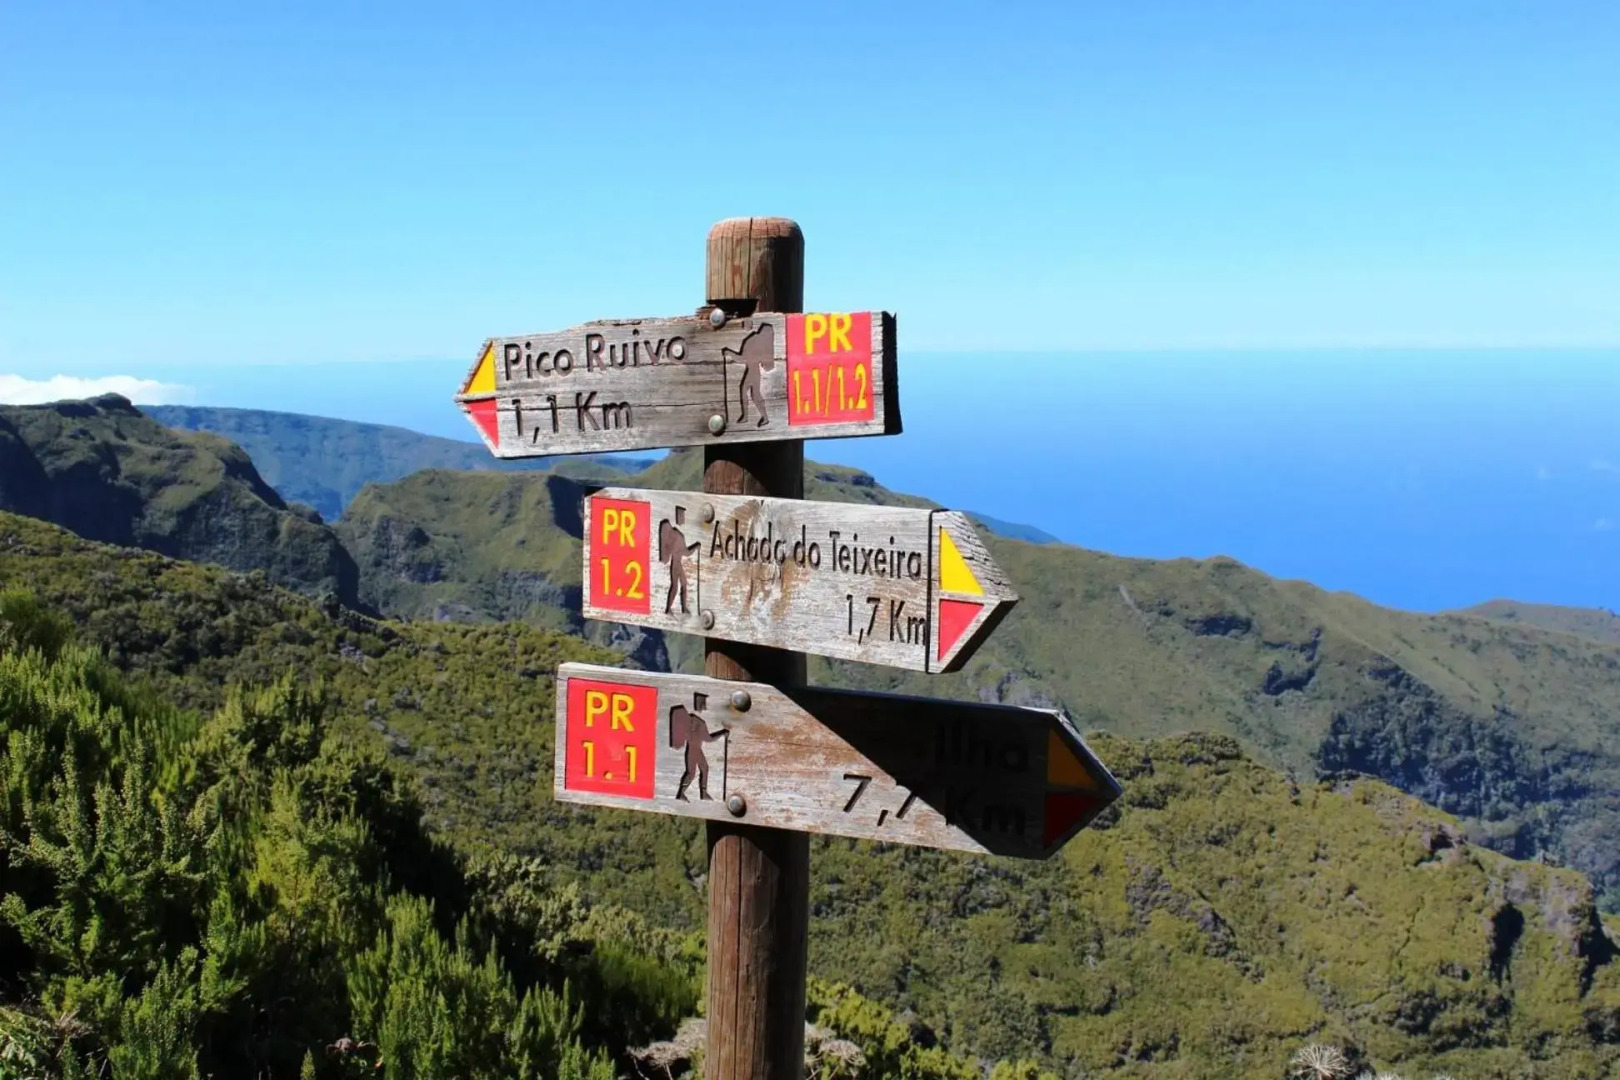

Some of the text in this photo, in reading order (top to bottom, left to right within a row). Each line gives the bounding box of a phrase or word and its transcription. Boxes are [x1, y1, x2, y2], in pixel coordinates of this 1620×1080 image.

[504, 329, 689, 381] Pico Ruivo
[805, 313, 853, 355] PR
[793, 362, 867, 418] 1.1/1.2
[511, 390, 633, 444] 1,1 Km
[602, 508, 637, 549] PR
[709, 519, 922, 581] Achada do Teixeira
[600, 557, 645, 599] 1.2
[846, 594, 927, 646] 1,7 Km
[584, 690, 636, 732] PR
[581, 740, 638, 783] 1.1
